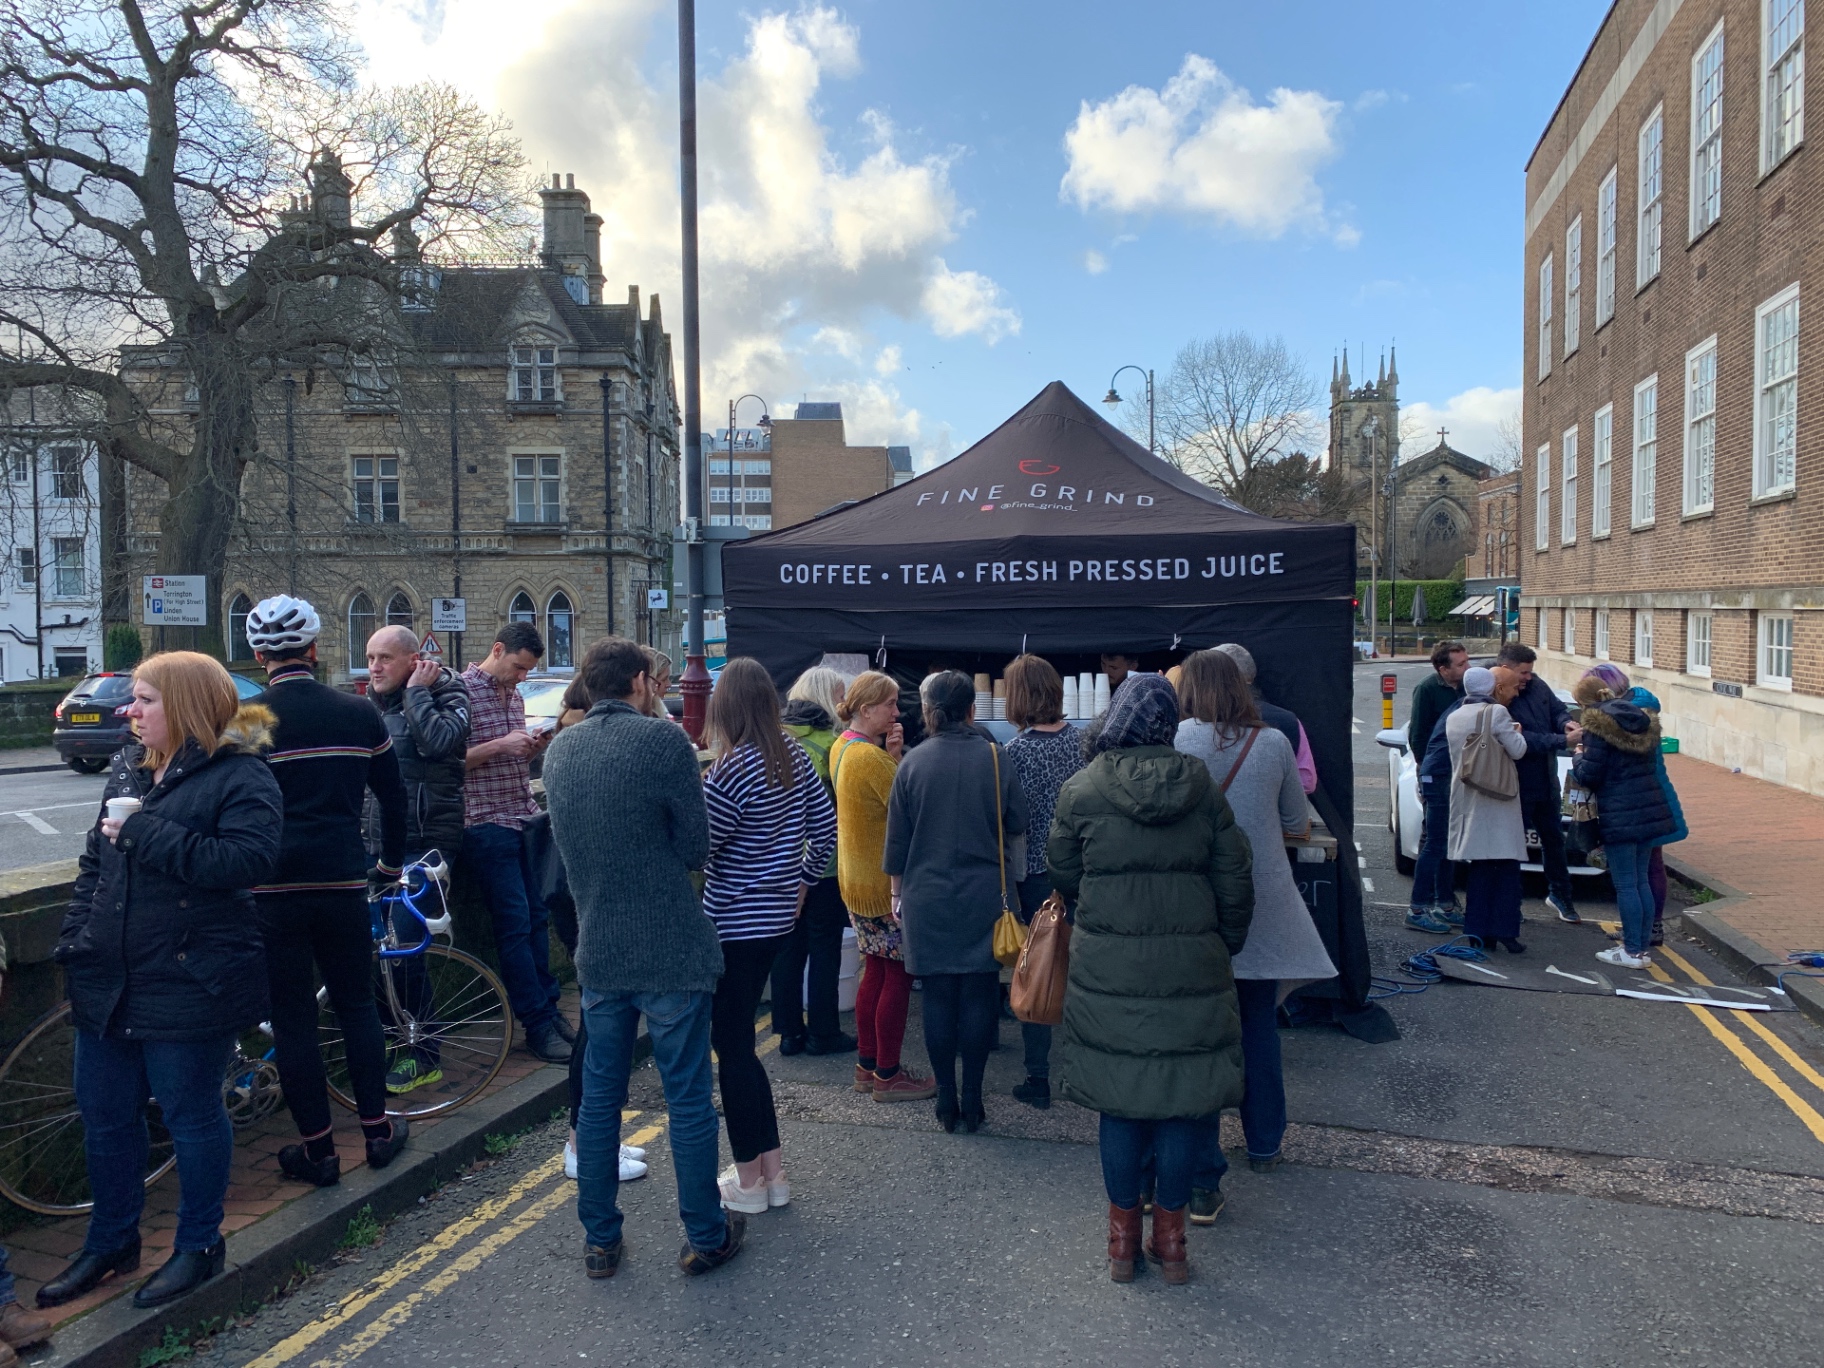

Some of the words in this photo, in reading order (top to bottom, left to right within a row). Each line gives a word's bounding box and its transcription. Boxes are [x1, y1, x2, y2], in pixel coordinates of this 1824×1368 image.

[916, 484, 1005, 506] FINE
[1030, 483, 1154, 507] GRIND
[780, 563, 872, 585] COFFEE
[899, 563, 947, 584] TEA
[975, 560, 1057, 583] FRESH
[1069, 558, 1190, 581] PRESSED
[1201, 552, 1284, 579] JUICE
[154, 600, 162, 612] P
